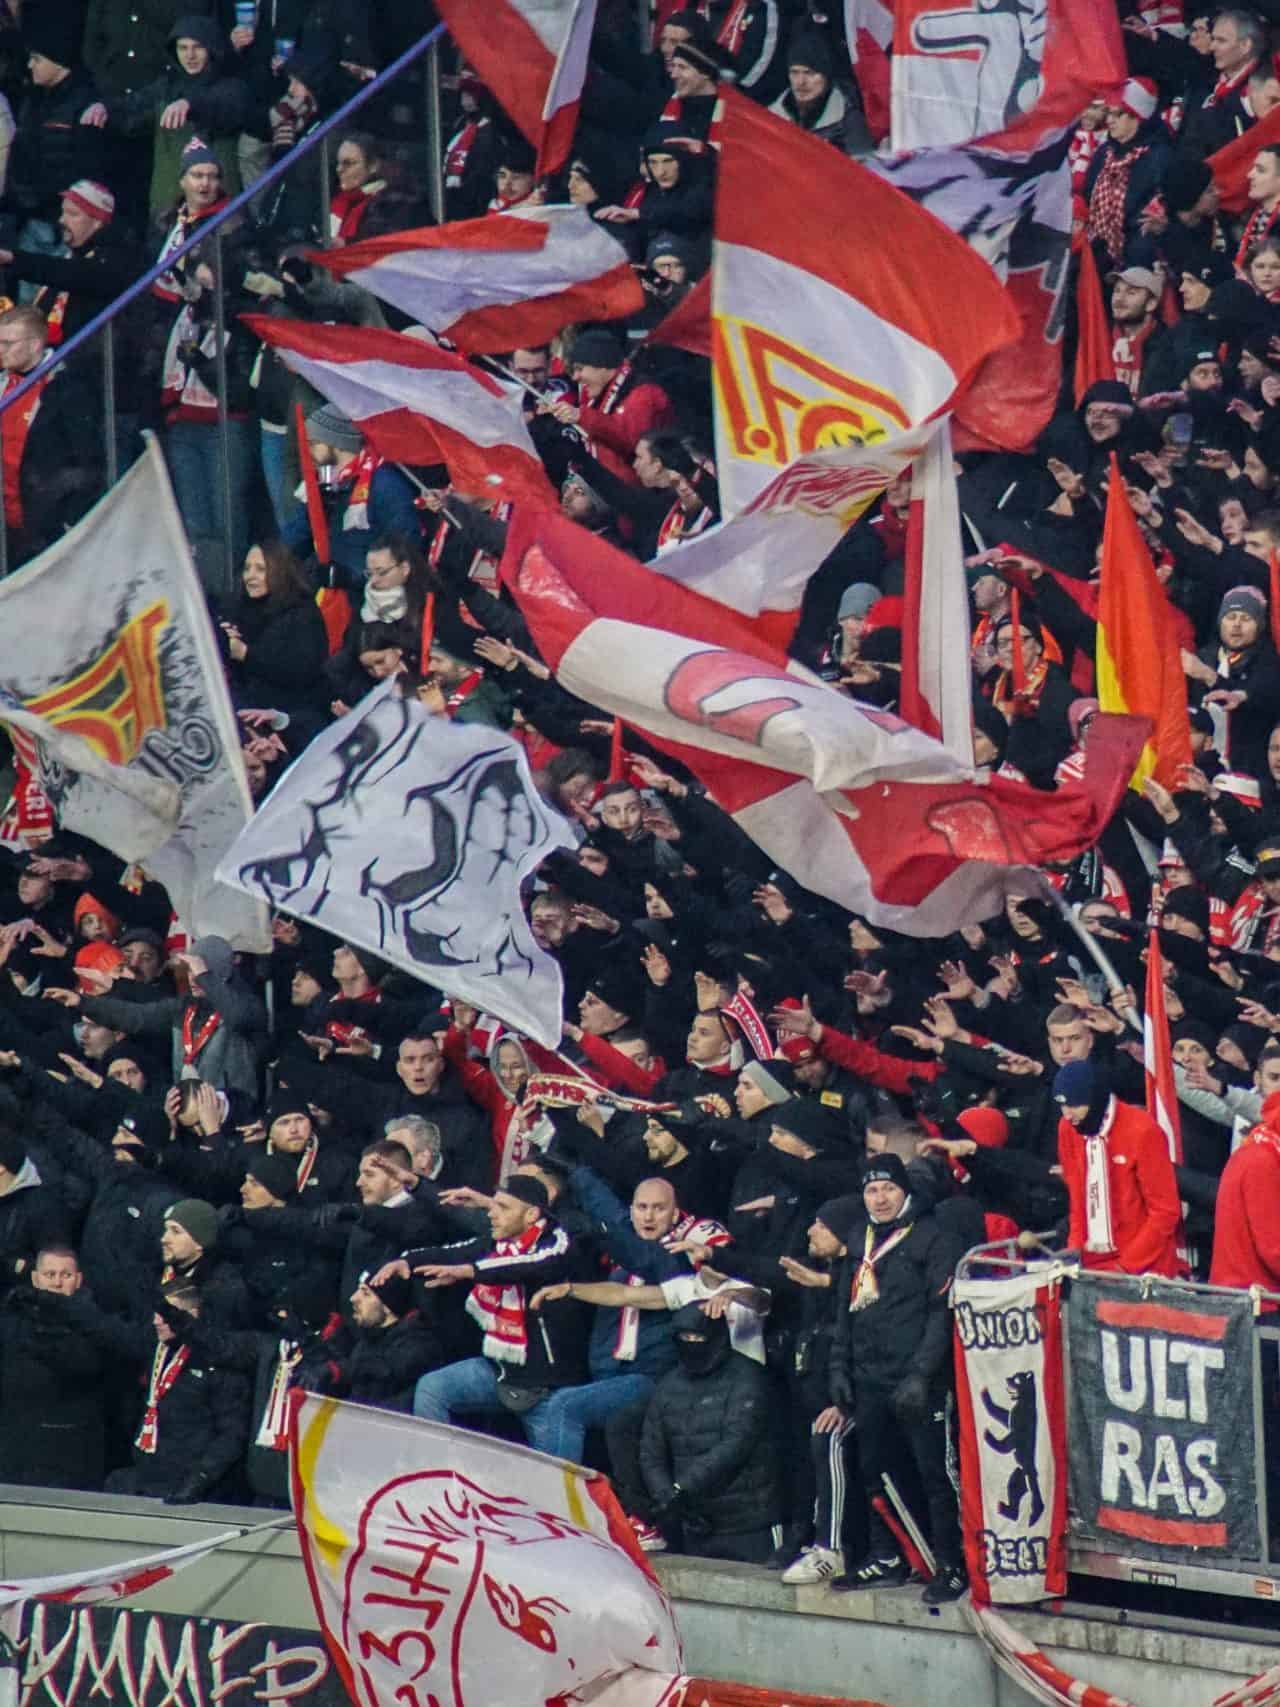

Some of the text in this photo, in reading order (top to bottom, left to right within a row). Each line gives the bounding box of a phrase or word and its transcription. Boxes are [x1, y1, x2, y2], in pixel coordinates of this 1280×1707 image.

[955, 1301, 1047, 1349] UNION
[1100, 1328, 1226, 1424] ULT
[1100, 1418, 1227, 1518] RAS
